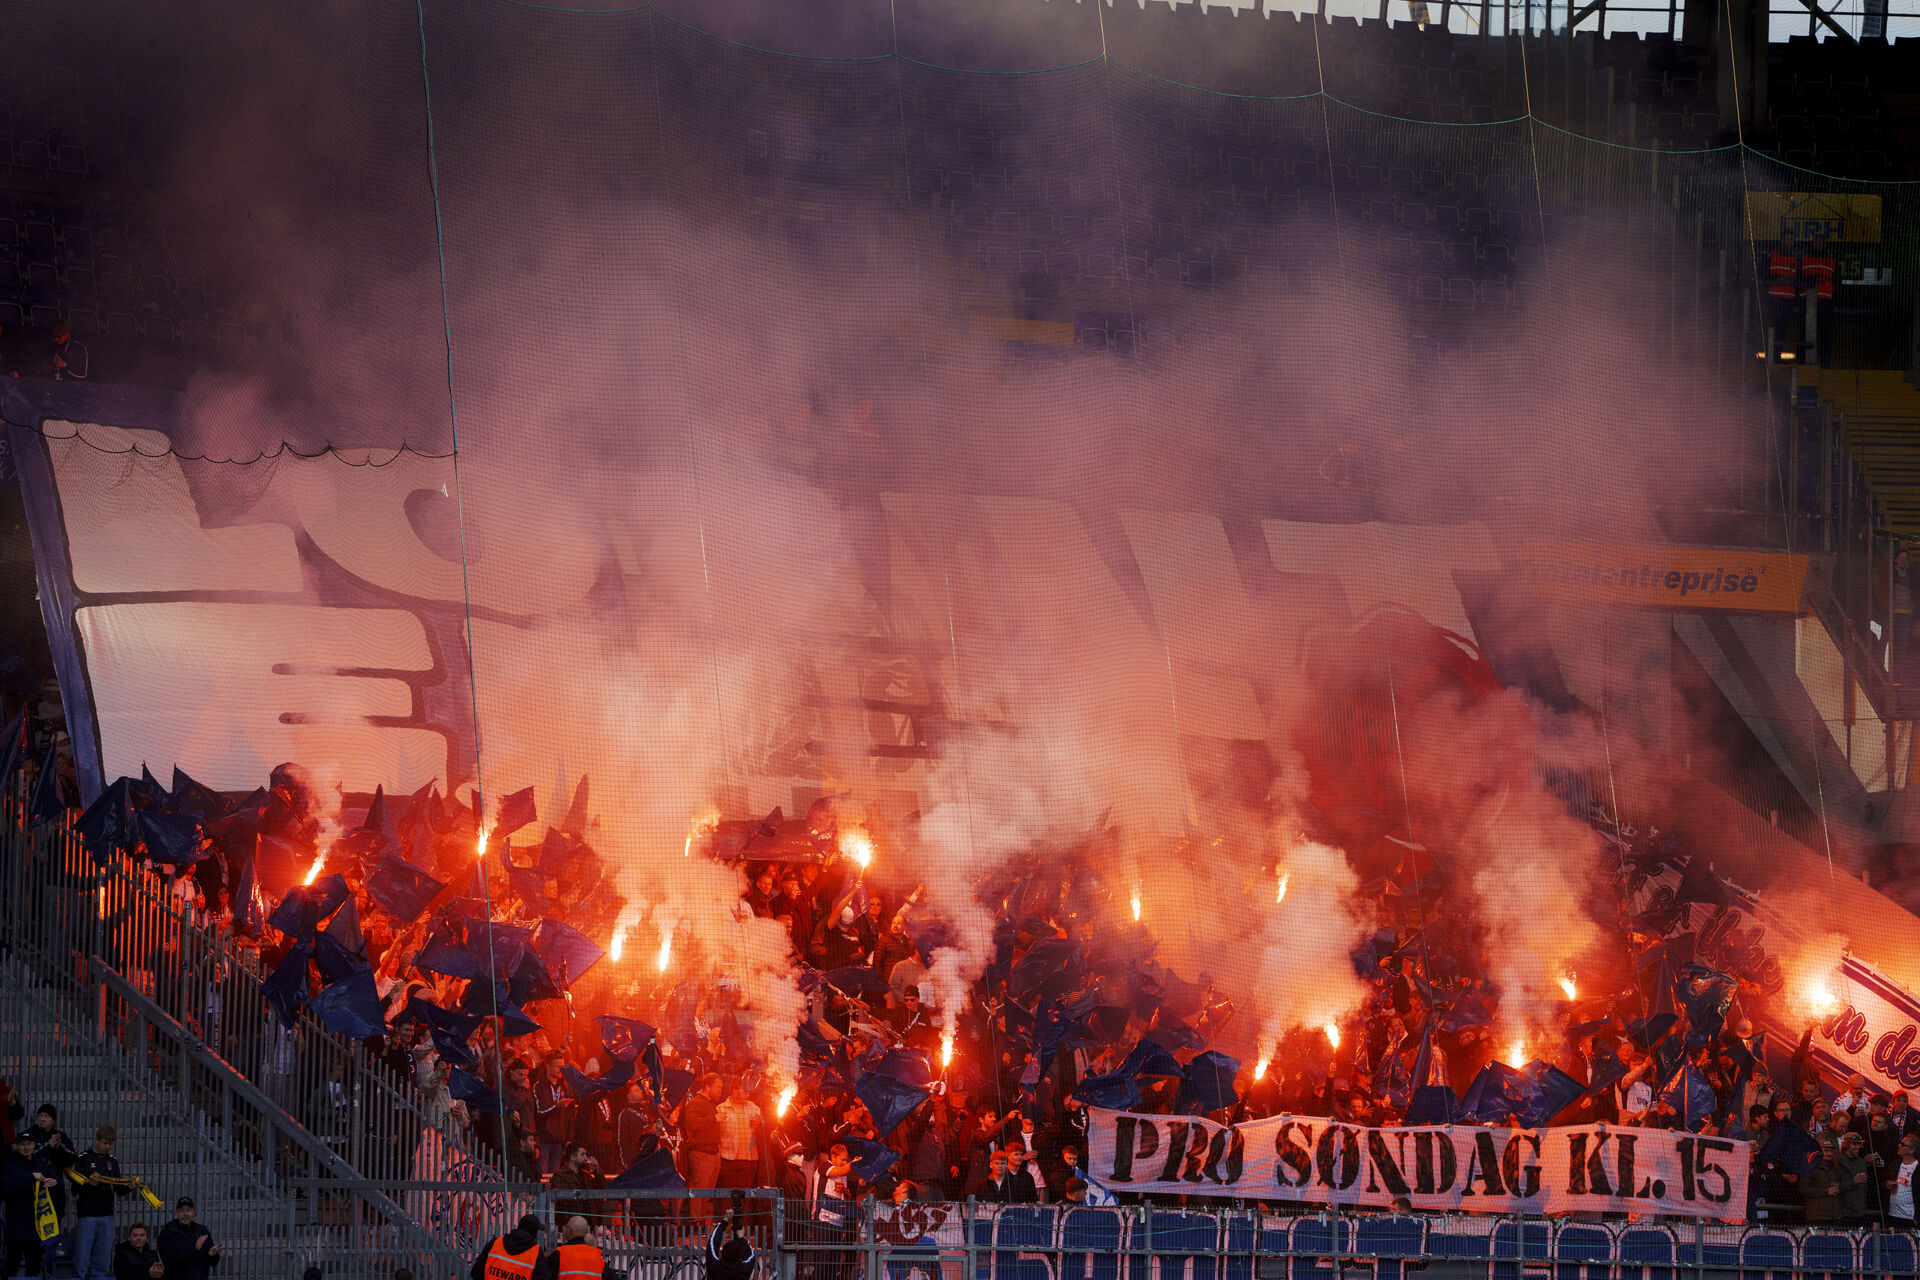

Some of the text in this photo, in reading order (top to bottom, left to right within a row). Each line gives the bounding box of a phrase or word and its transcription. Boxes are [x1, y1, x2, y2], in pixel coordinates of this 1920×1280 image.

[1780, 219, 1844, 239] HRH
[1108, 1116, 1735, 1203] PRO SØNDAG KL. 15
